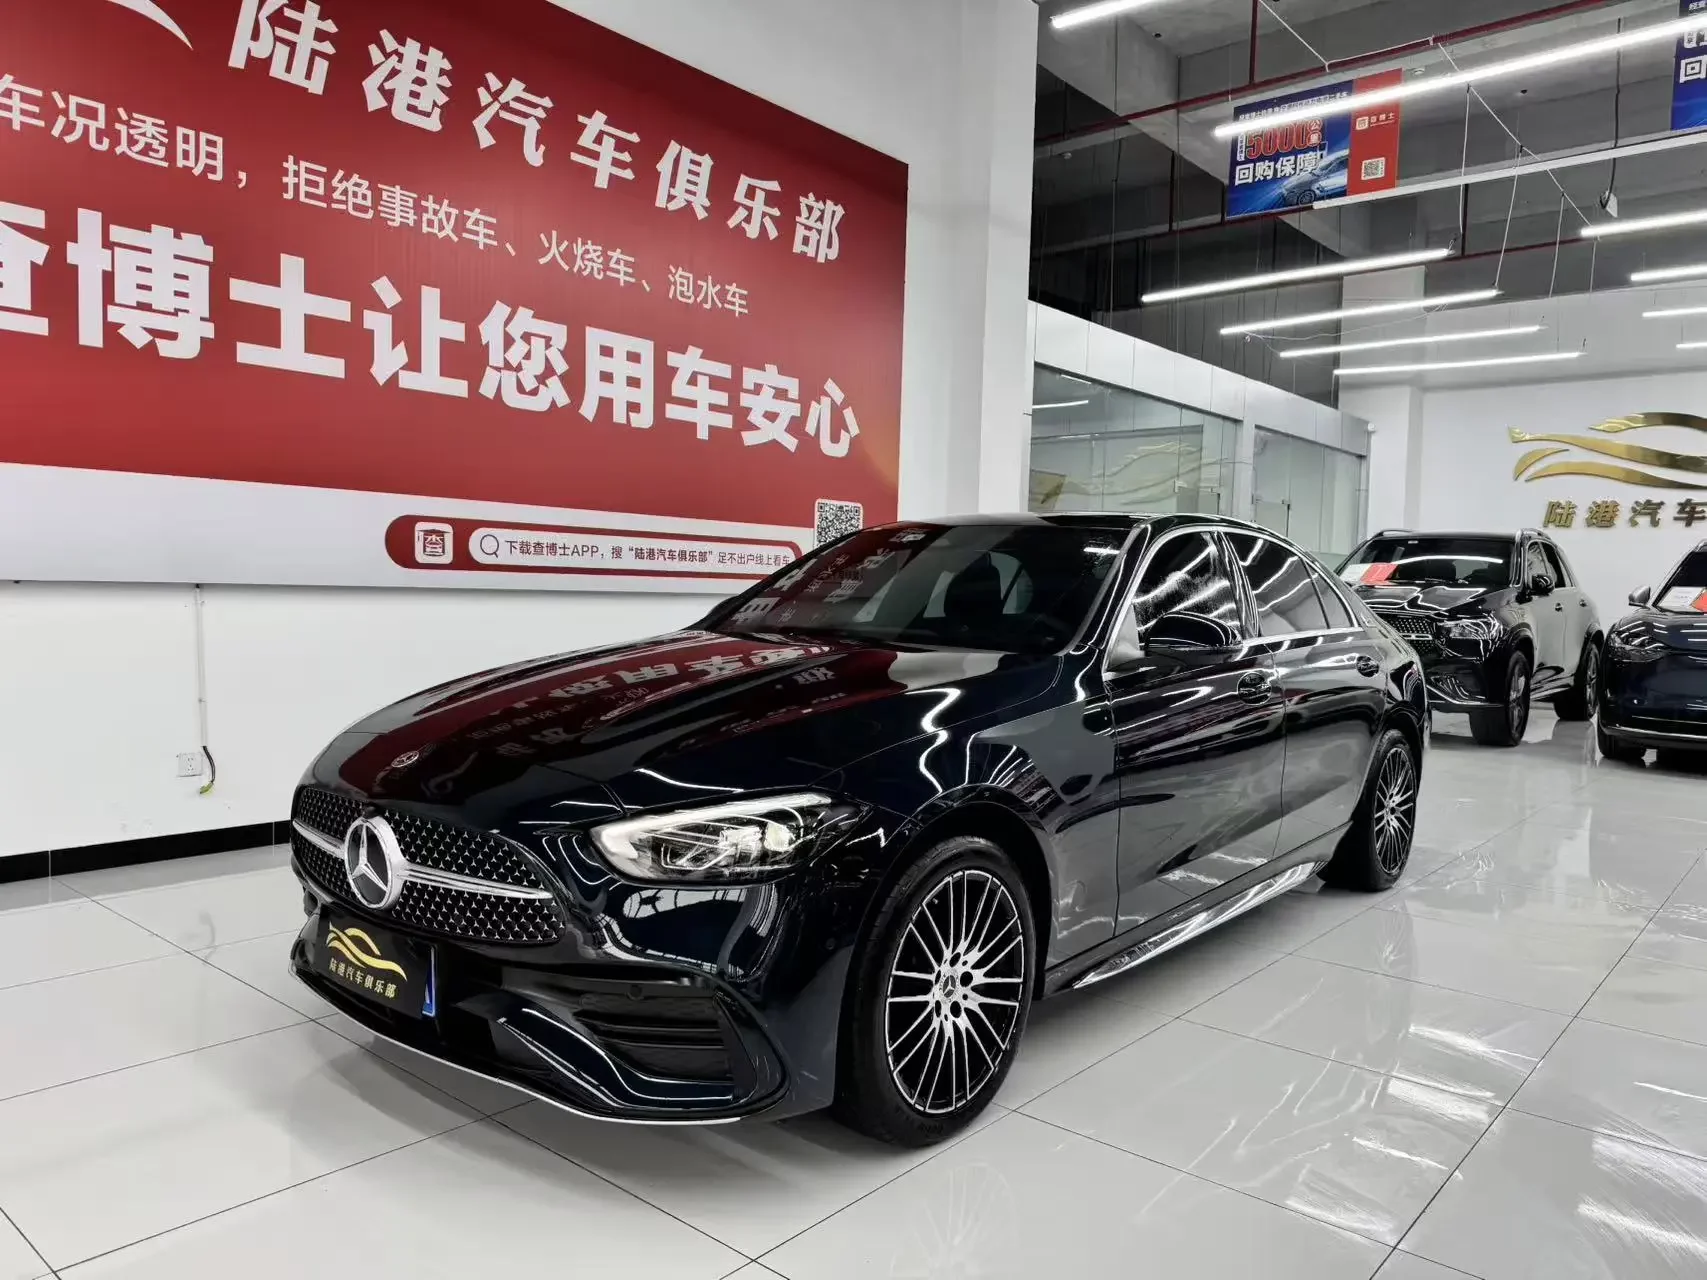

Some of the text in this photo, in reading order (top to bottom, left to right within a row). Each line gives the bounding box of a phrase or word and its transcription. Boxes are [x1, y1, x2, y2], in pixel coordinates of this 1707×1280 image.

[228, 0, 845, 263] 陆港汽车俱乐部
[1543, 498, 1707, 528] 陆港汽车
